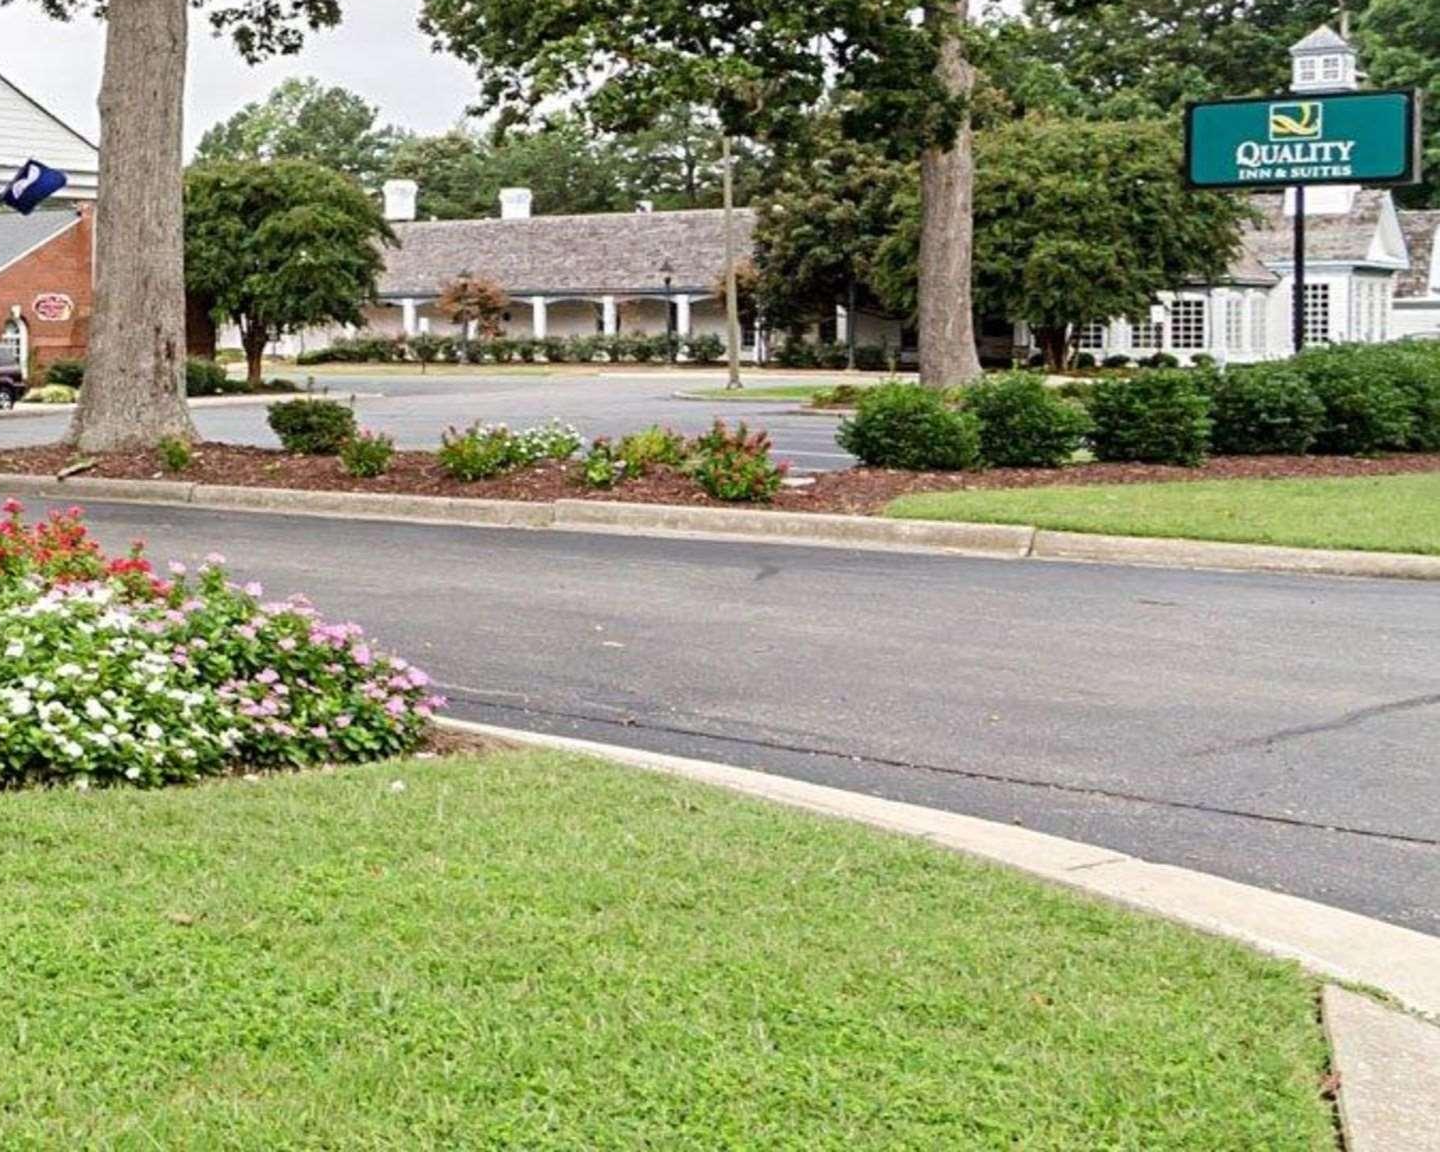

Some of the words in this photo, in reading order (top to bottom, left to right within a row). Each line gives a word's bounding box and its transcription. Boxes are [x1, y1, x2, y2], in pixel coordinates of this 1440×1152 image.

[1236, 141, 1355, 167] QUALITY
[1239, 168, 1272, 180] INN
[1274, 167, 1286, 178] &
[1290, 165, 1352, 178] SUITES
